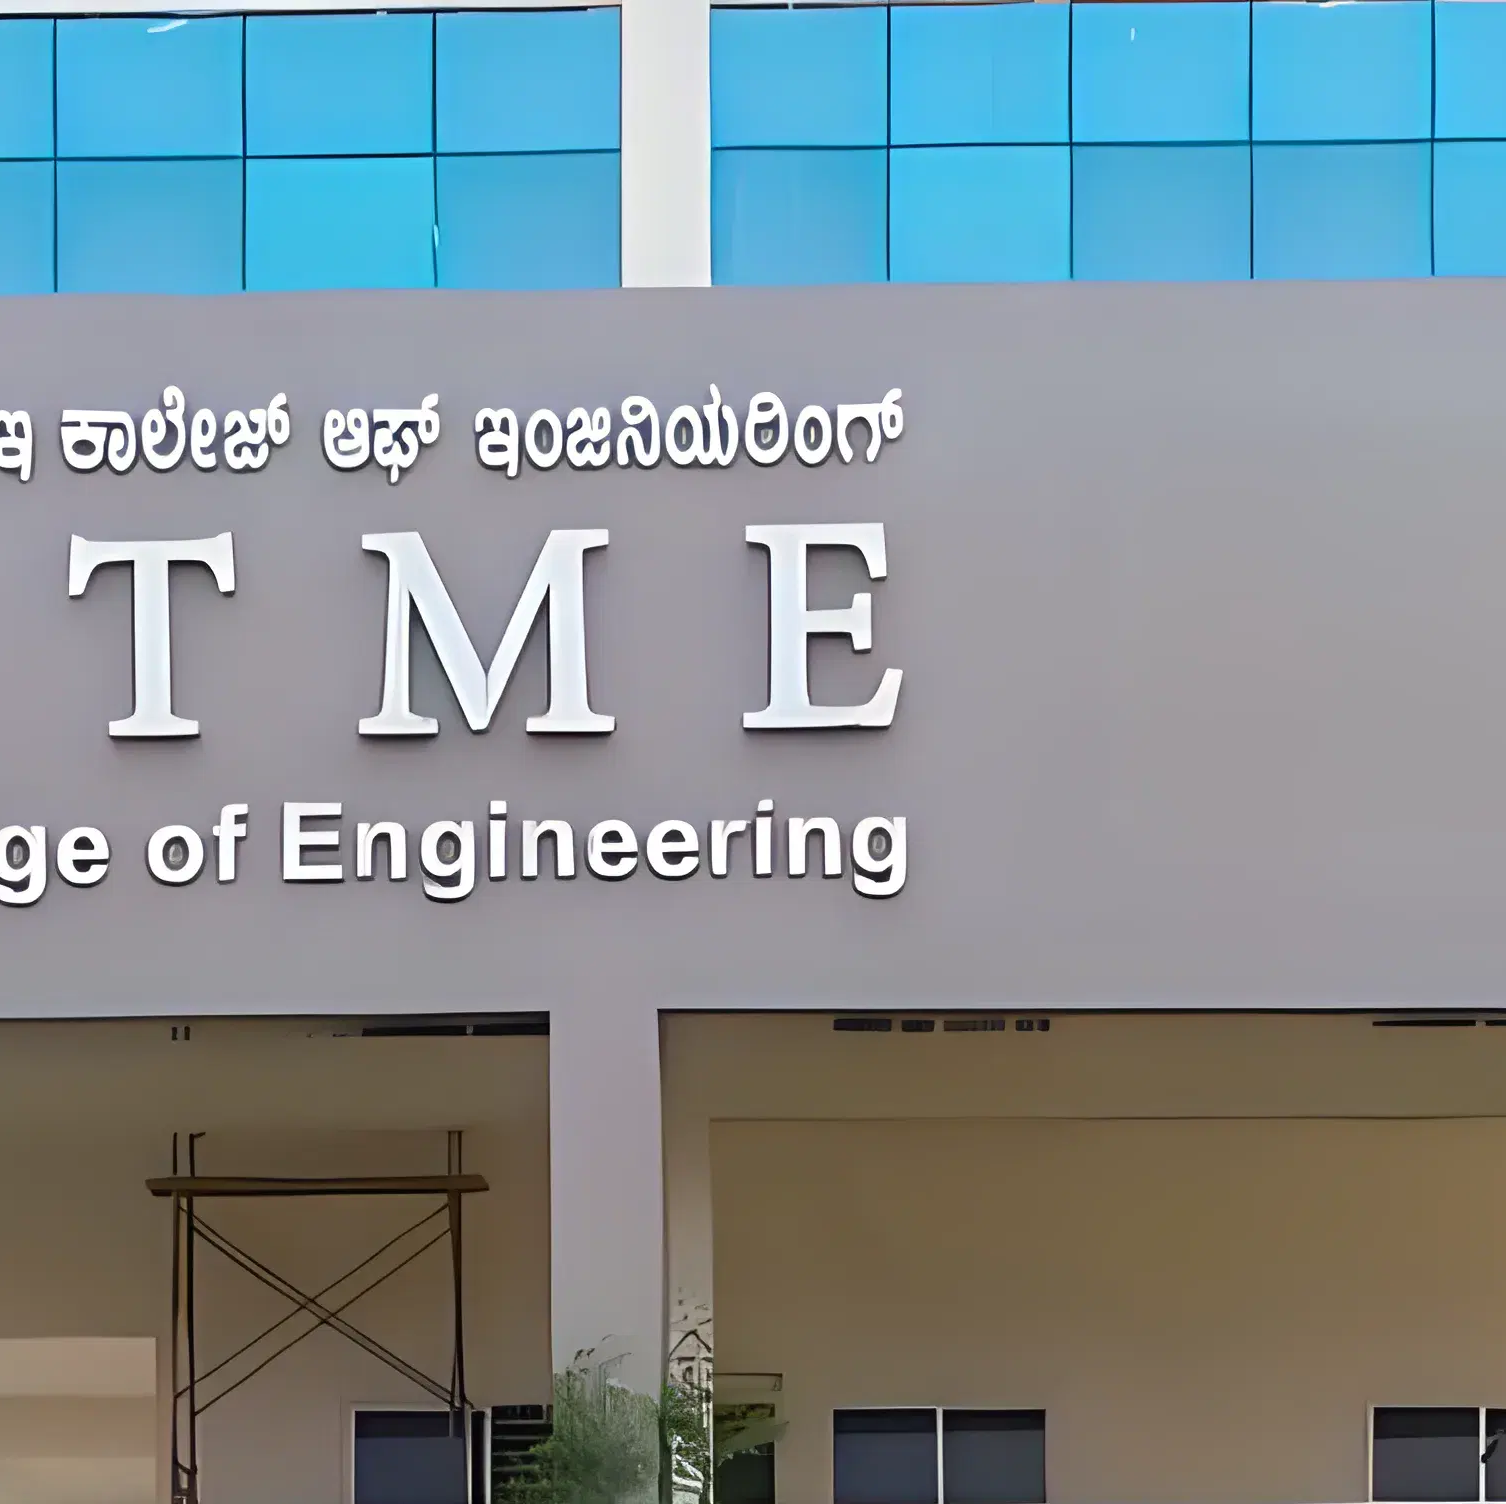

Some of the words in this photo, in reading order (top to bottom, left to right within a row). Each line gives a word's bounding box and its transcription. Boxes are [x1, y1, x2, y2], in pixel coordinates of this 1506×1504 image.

[60, 385, 290, 472] ಕಾಲೇಜ್
[147, 802, 250, 884] of
[282, 799, 908, 900] Engineering
